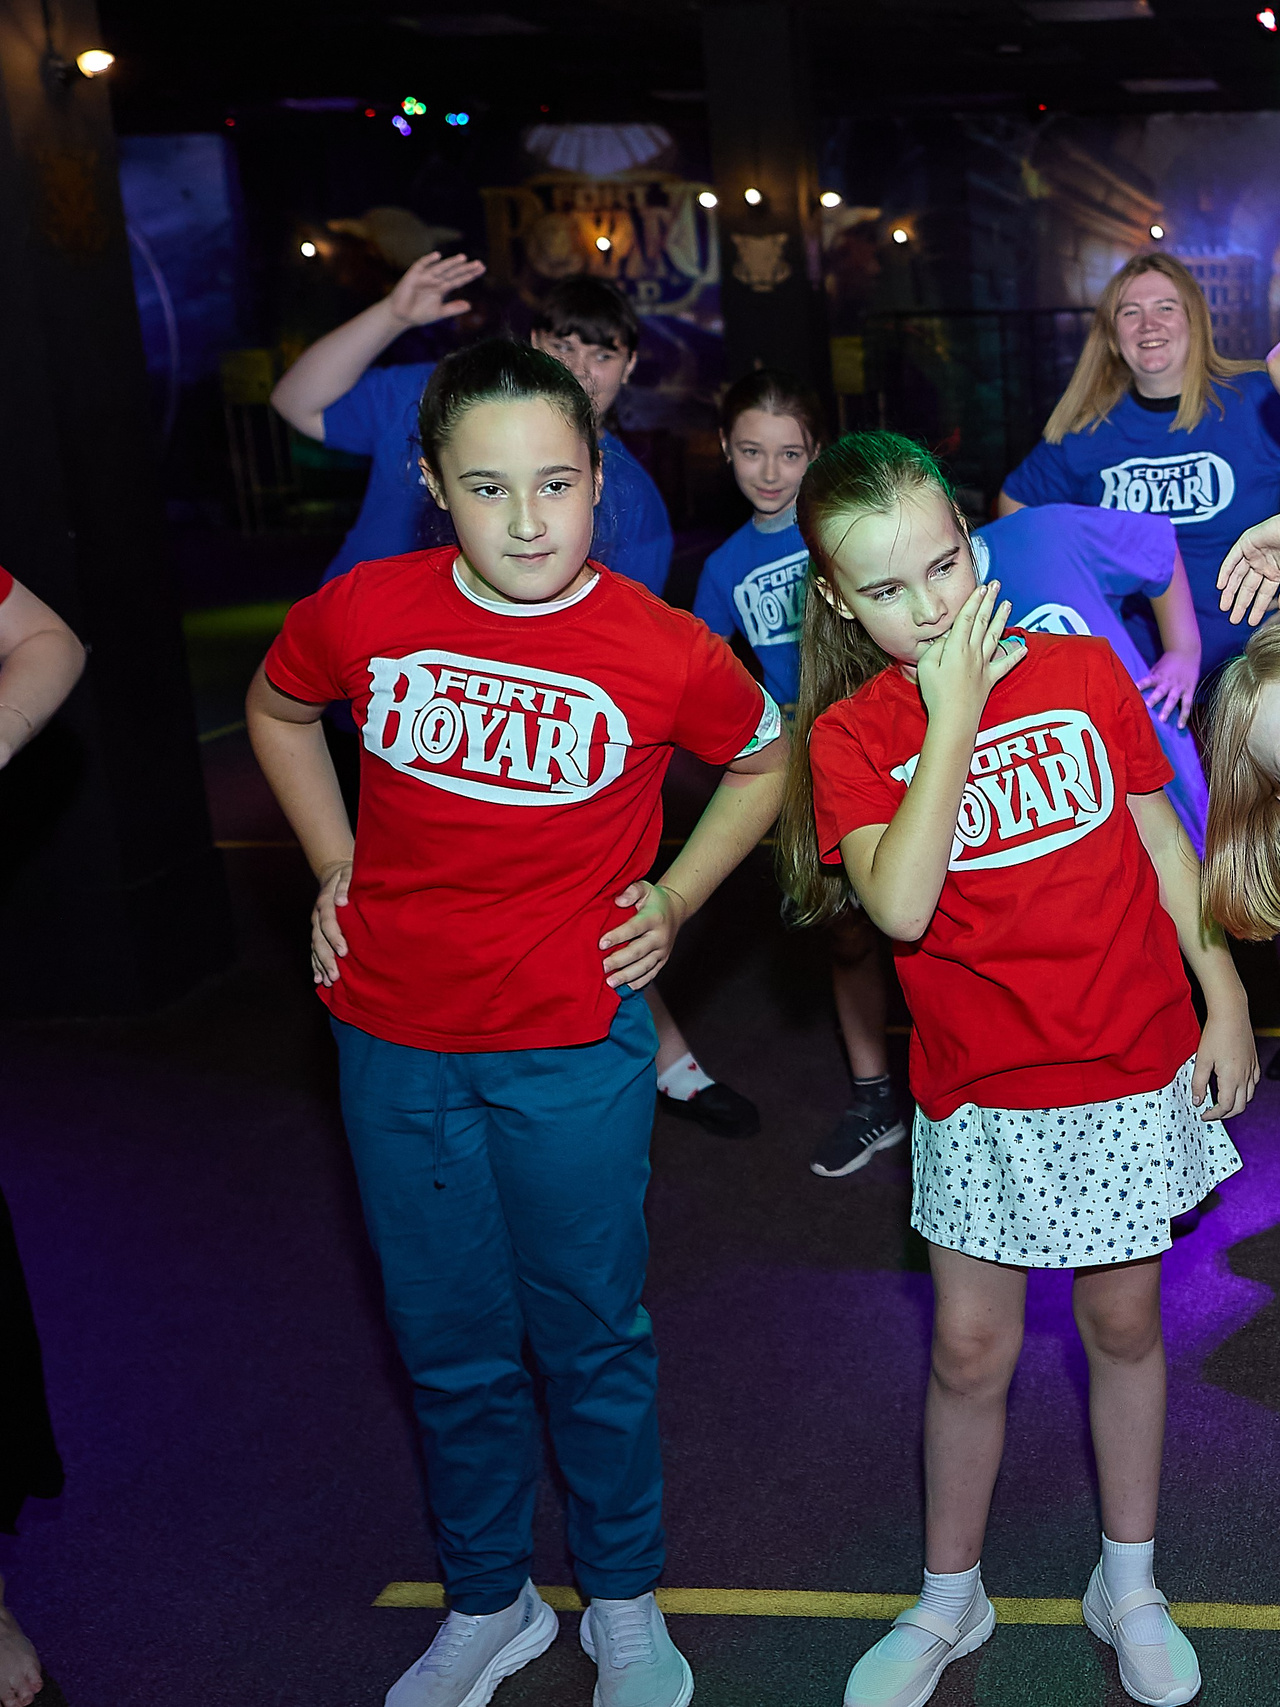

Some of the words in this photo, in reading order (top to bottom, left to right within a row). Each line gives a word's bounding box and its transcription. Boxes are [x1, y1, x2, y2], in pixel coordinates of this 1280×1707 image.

[1100, 453, 1235, 516] BOYARD
[1133, 463, 1194, 480] FORT
[435, 668, 566, 714] FORT
[361, 656, 633, 798] BOYARD
[970, 729, 1050, 776] ORT
